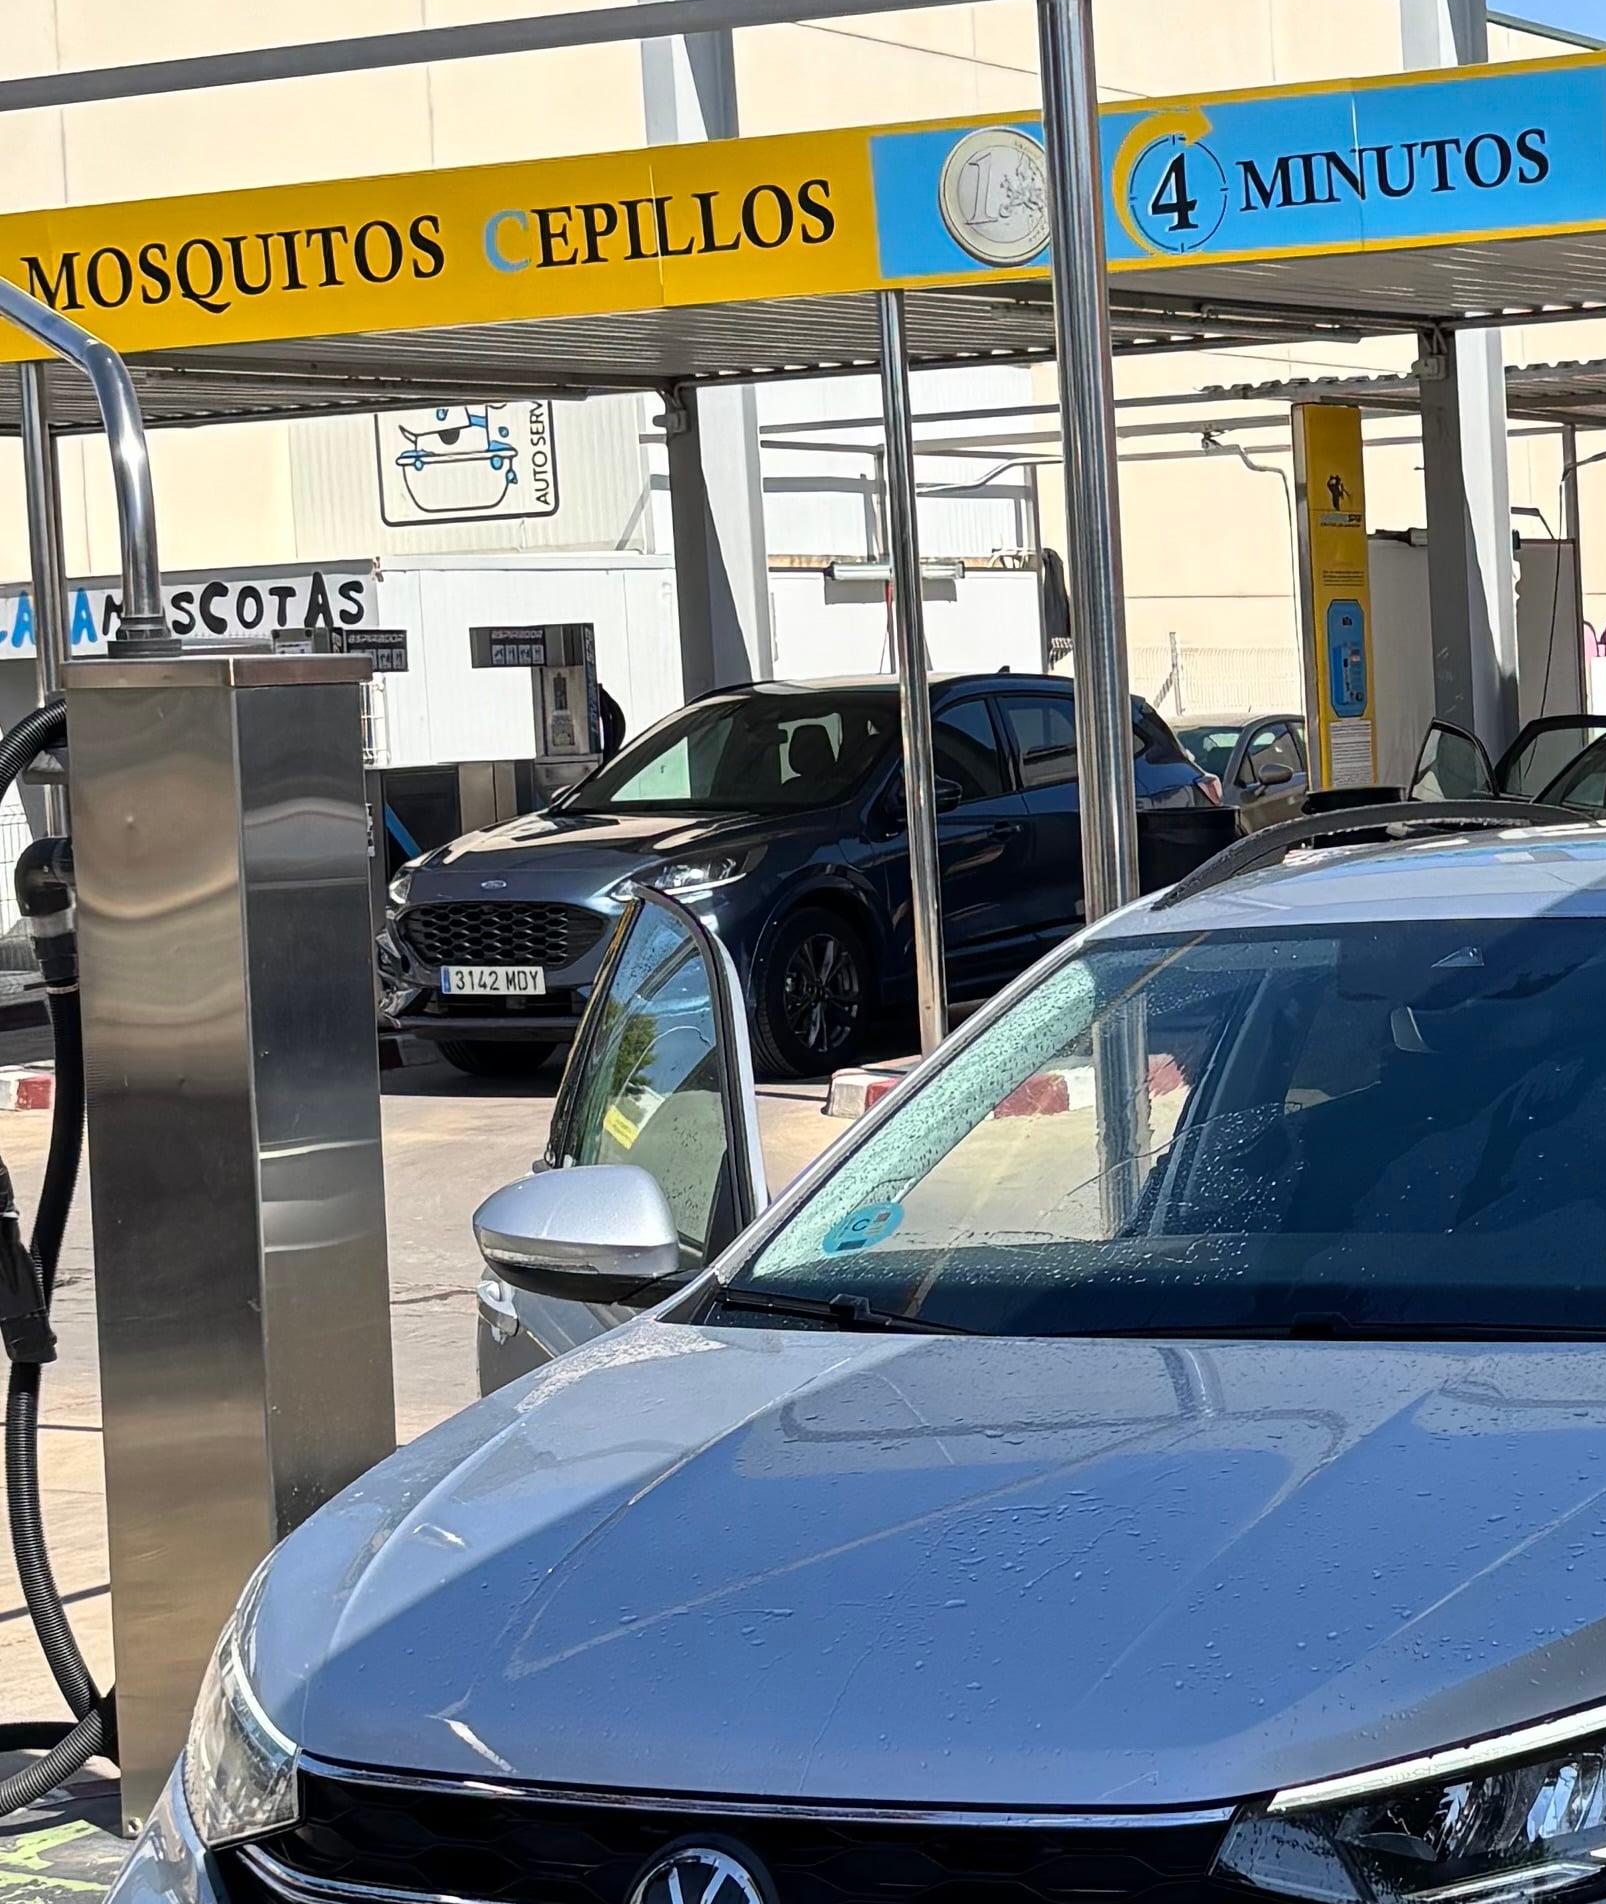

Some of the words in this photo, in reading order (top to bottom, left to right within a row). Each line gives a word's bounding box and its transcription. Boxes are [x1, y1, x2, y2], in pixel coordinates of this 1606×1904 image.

[1150, 152, 1199, 233] 4
[1237, 127, 1551, 213] MINUTOS
[22, 214, 446, 315] MOSQUITOS
[484, 178, 837, 274] CEPILLOS
[532, 451, 550, 505] AUTO
[455, 971, 500, 991] 3142
[505, 970, 538, 991] MDY
